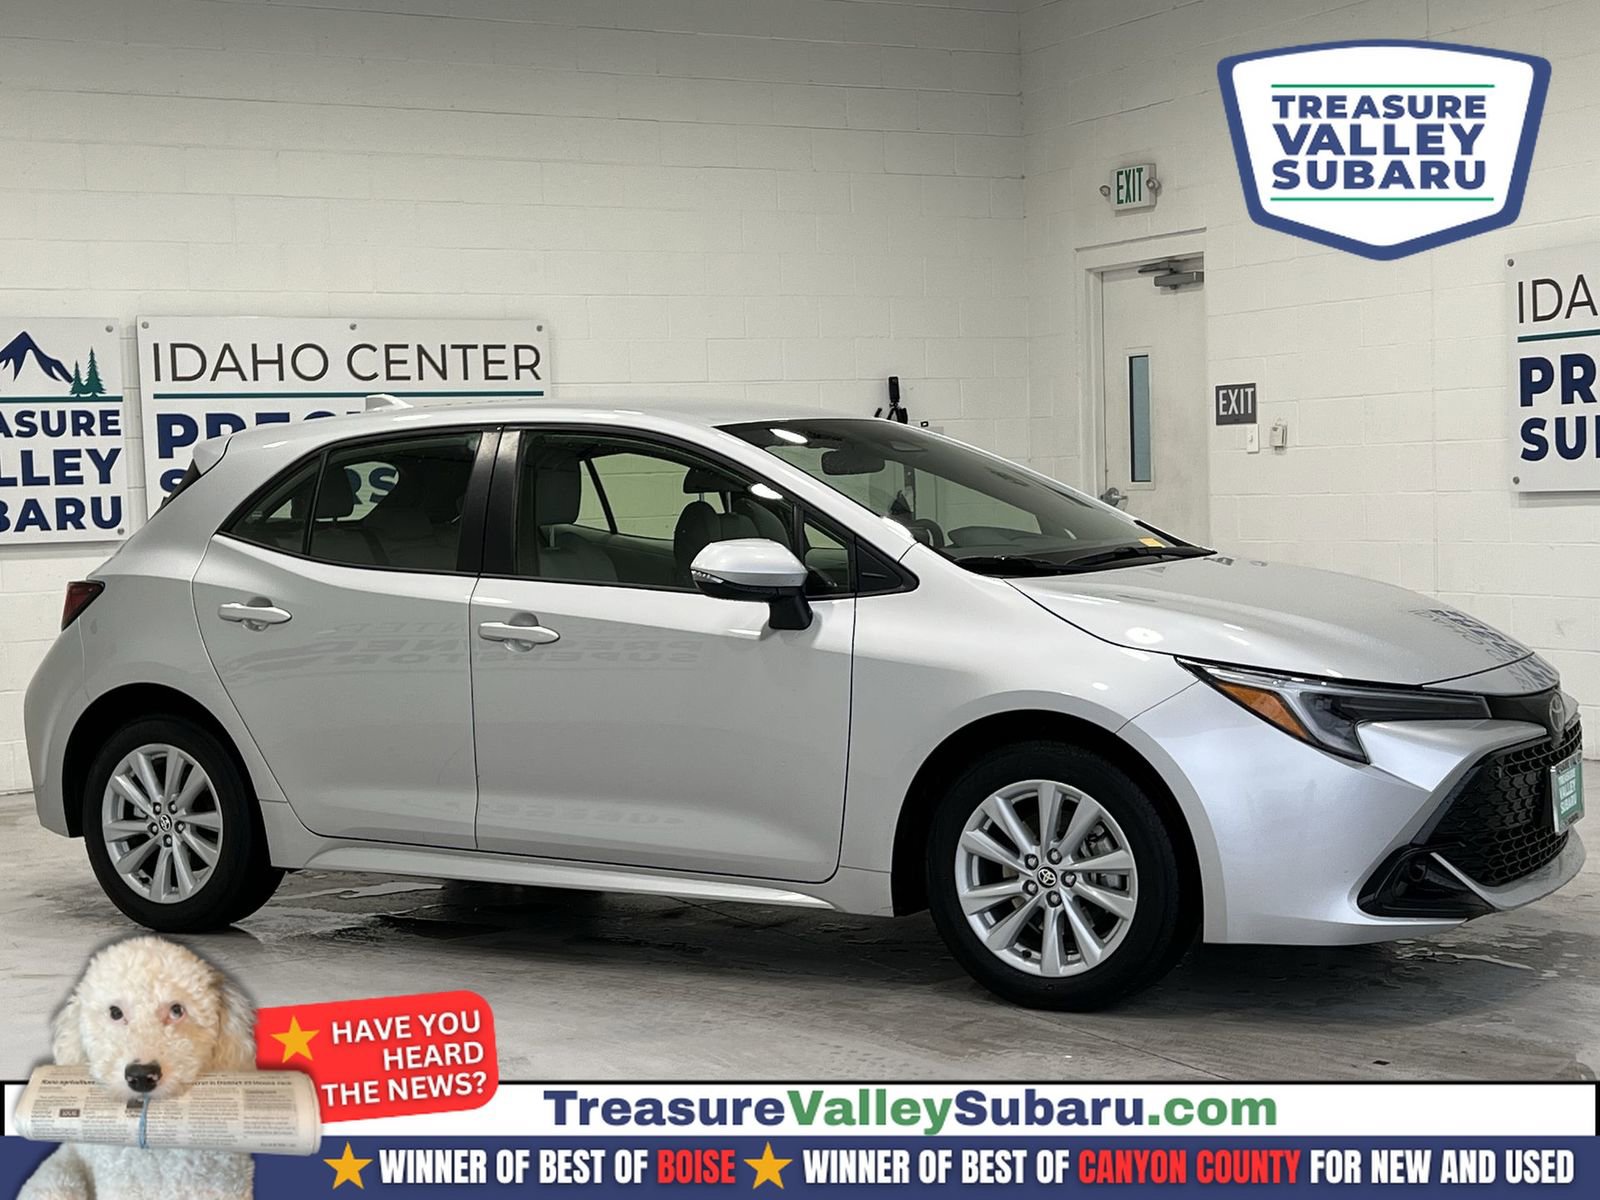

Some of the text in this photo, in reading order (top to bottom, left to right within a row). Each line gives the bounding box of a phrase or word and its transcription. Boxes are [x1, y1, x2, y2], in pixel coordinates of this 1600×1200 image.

[1116, 166, 1144, 205] EXIT
[1518, 273, 1599, 324] IDA
[152, 342, 542, 383] IDAHO CENTER
[1519, 353, 1598, 408] PR
[1218, 387, 1255, 416] EXIT
[1520, 414, 1600, 463] SU
